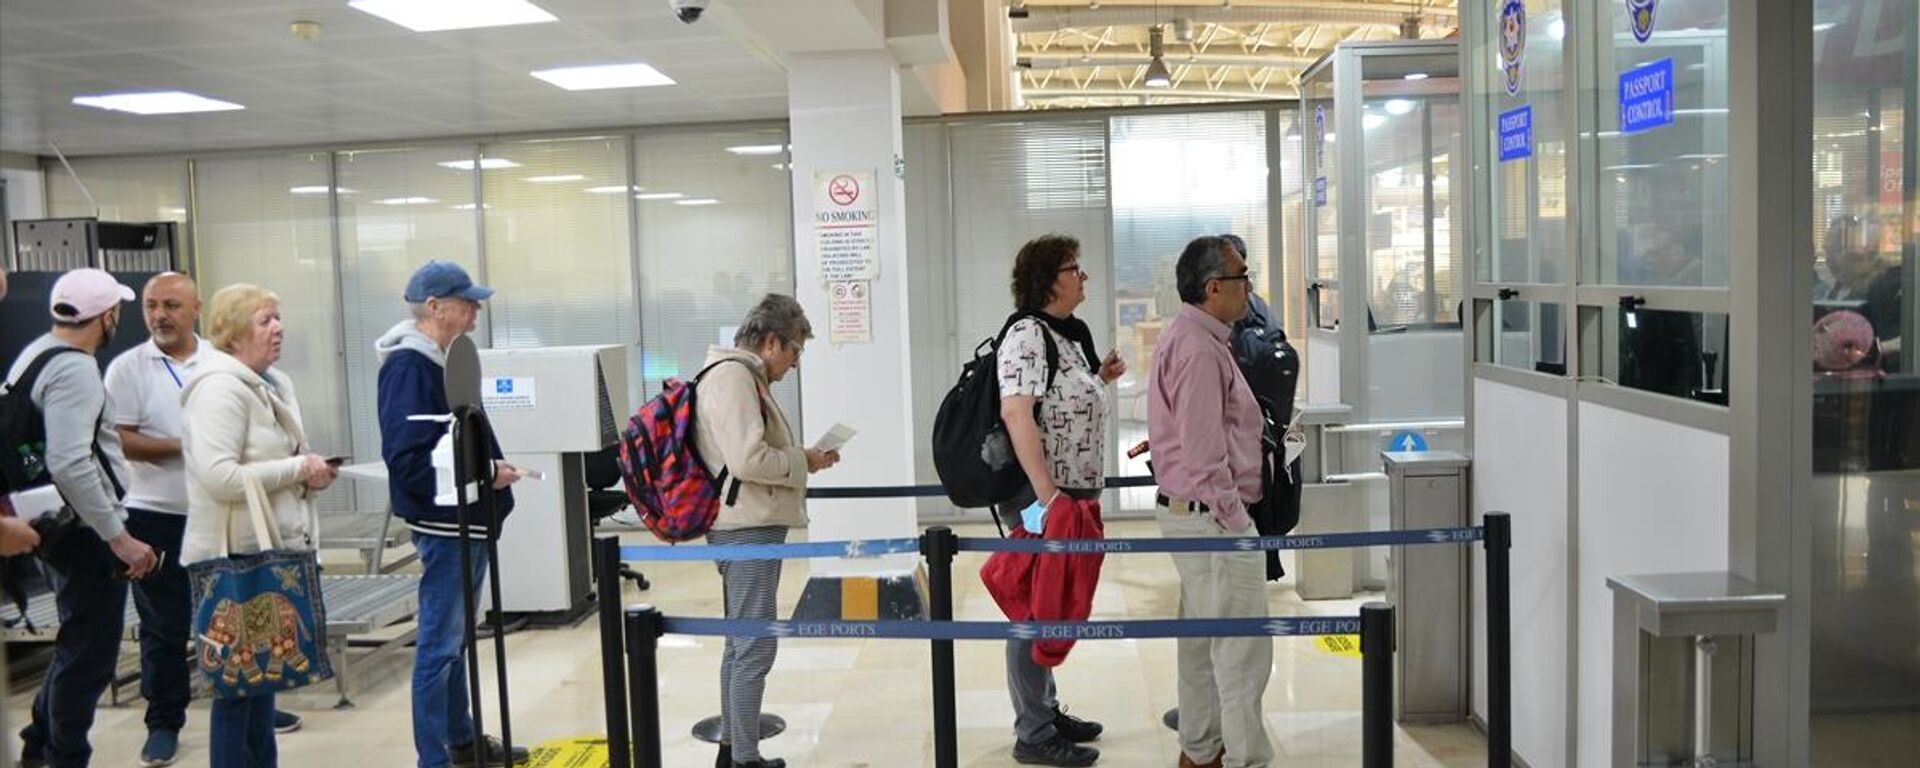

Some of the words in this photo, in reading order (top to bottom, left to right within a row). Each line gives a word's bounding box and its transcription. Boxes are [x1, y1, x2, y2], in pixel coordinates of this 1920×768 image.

[1624, 70, 1666, 100] PASSPORT
[1627, 98, 1663, 124] CONTROL
[1501, 111, 1527, 132] PASSPORT
[1503, 132, 1526, 152] CONTROL
[815, 211, 829, 222] NO
[831, 210, 875, 222] SMOKING
[1068, 540, 1089, 551] EGE
[1095, 540, 1131, 551] PORTS
[1260, 538, 1283, 549] EGE
[1286, 536, 1323, 549] PORTS
[798, 622, 828, 635] EGE
[830, 622, 876, 635] PORTS
[1042, 625, 1073, 638] EGE
[1076, 624, 1124, 638] PORTS
[1300, 620, 1330, 633] EGE
